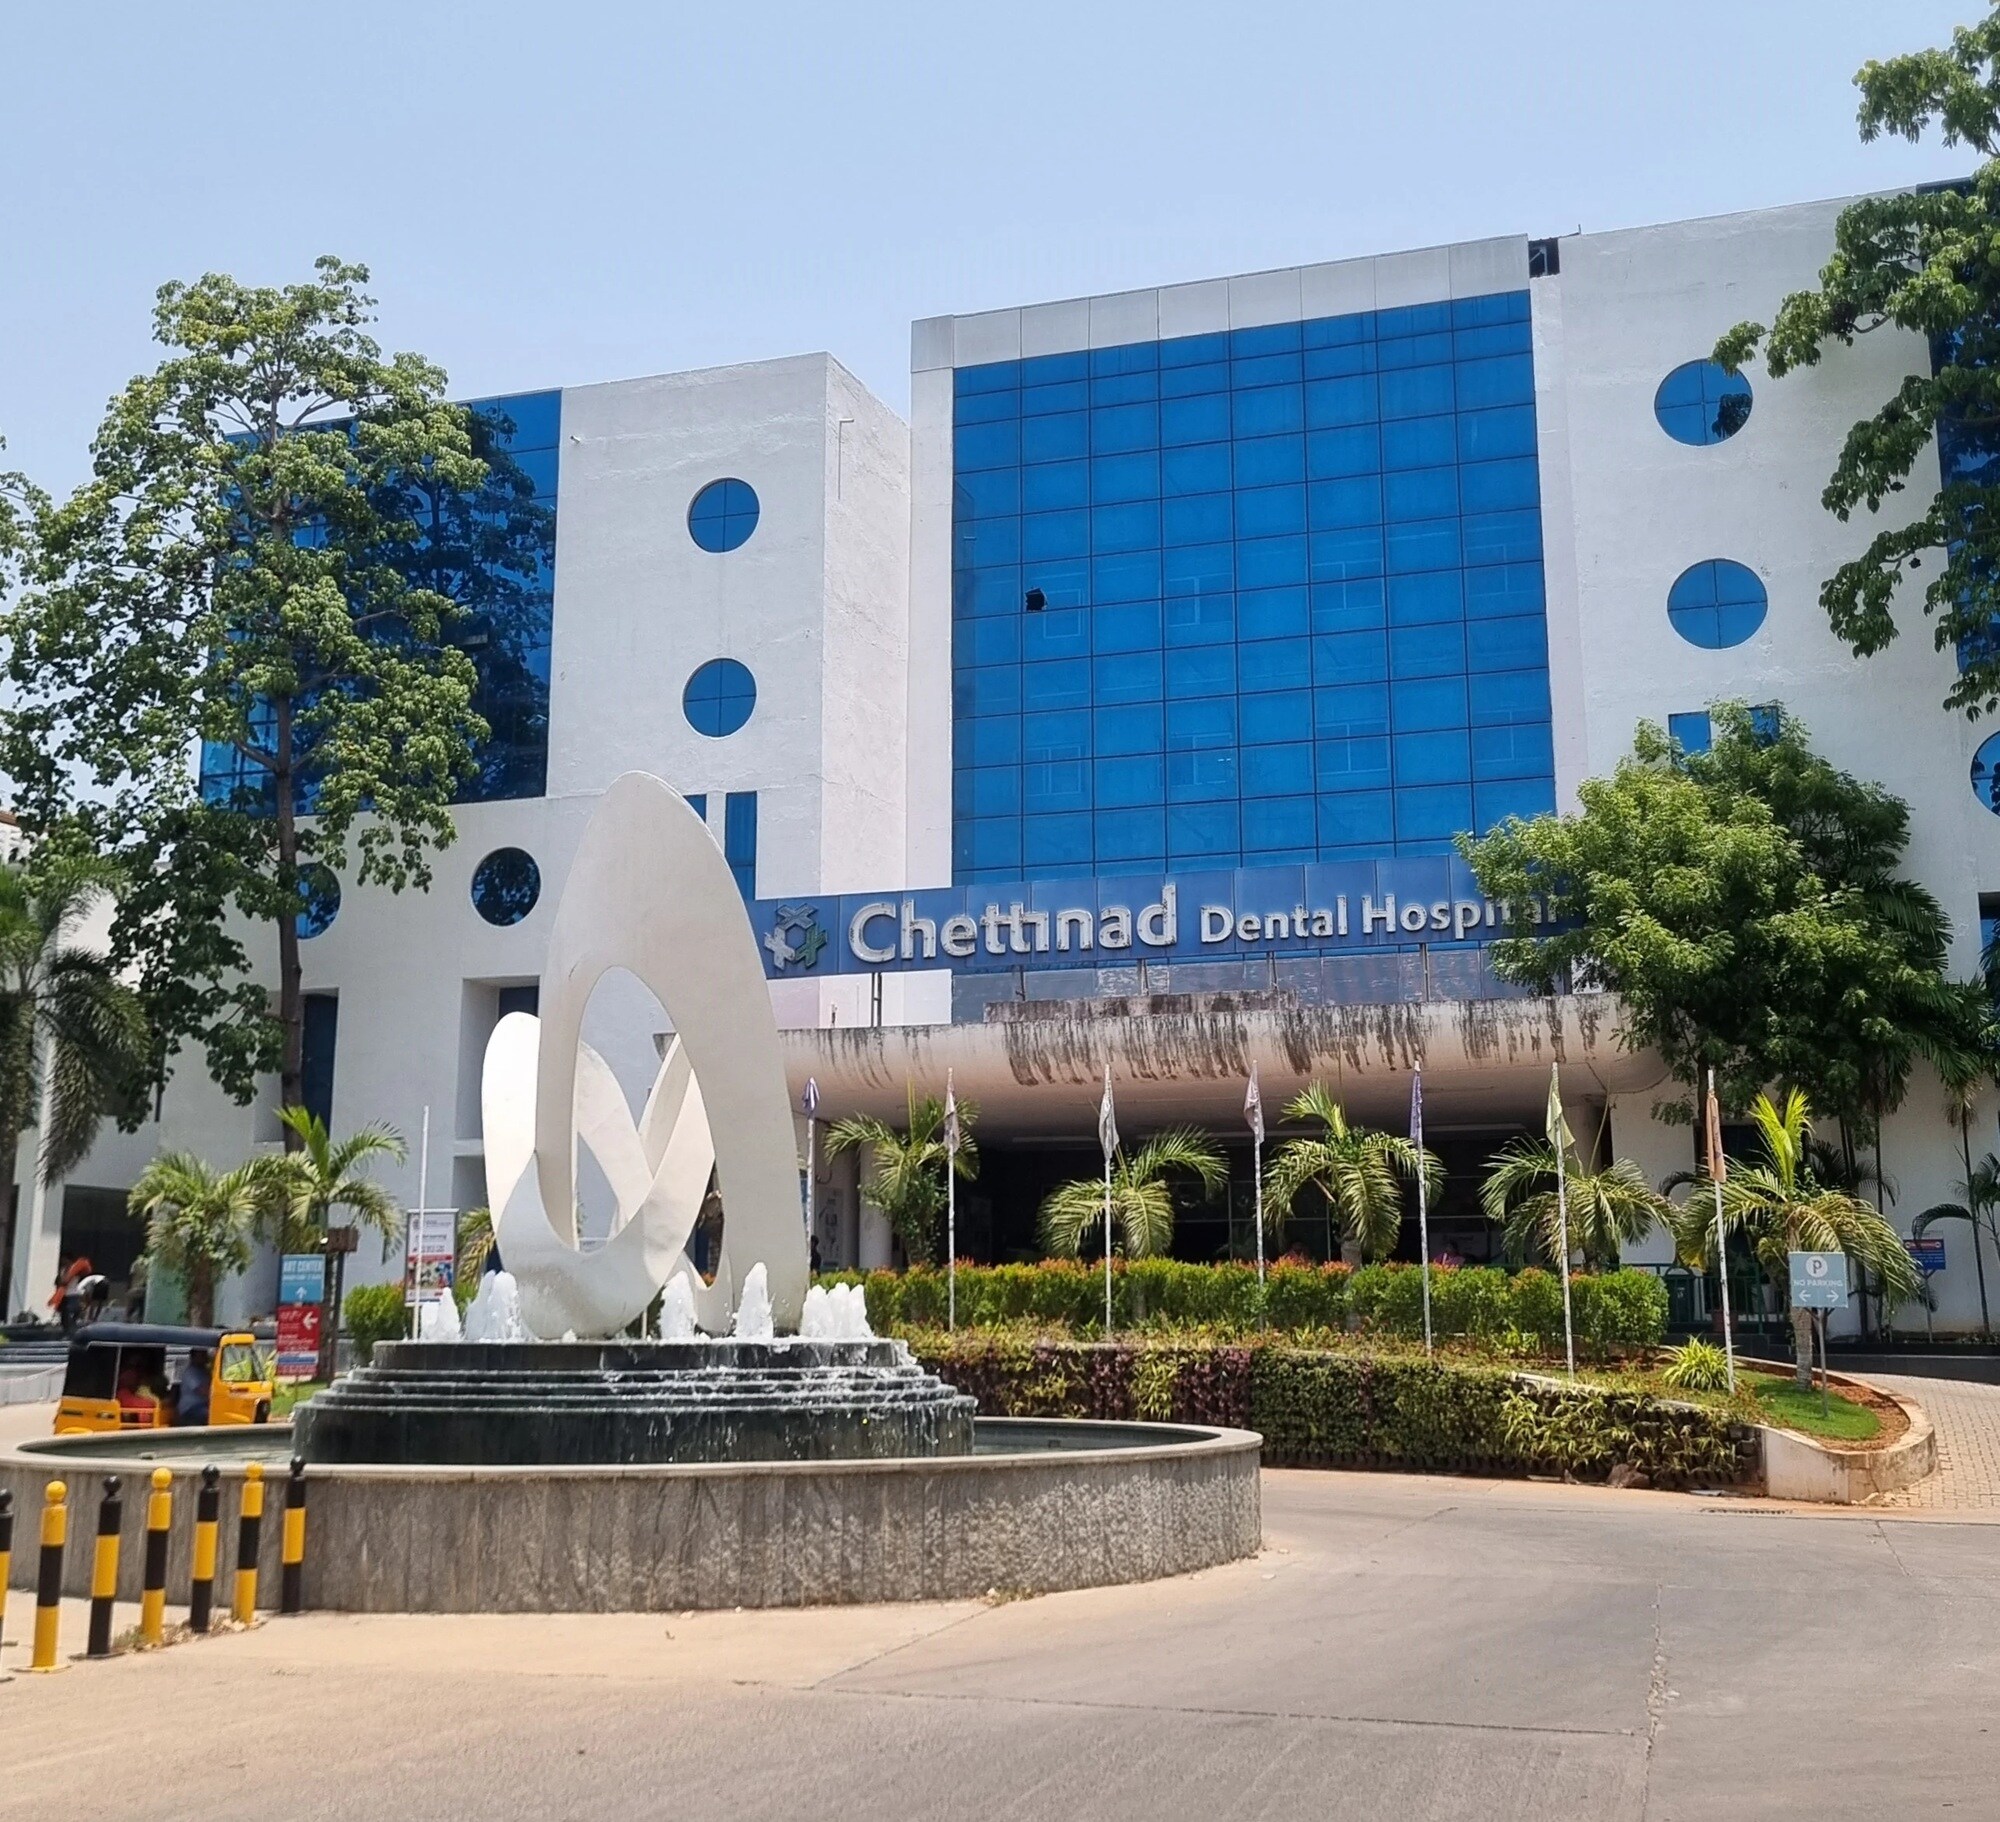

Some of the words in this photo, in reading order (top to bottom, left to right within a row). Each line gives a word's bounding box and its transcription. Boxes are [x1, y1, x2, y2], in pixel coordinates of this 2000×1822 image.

[849, 882, 1177, 963] Chettinad
[1200, 894, 1348, 943] Dental
[1806, 1279, 1844, 1287] PARKING
